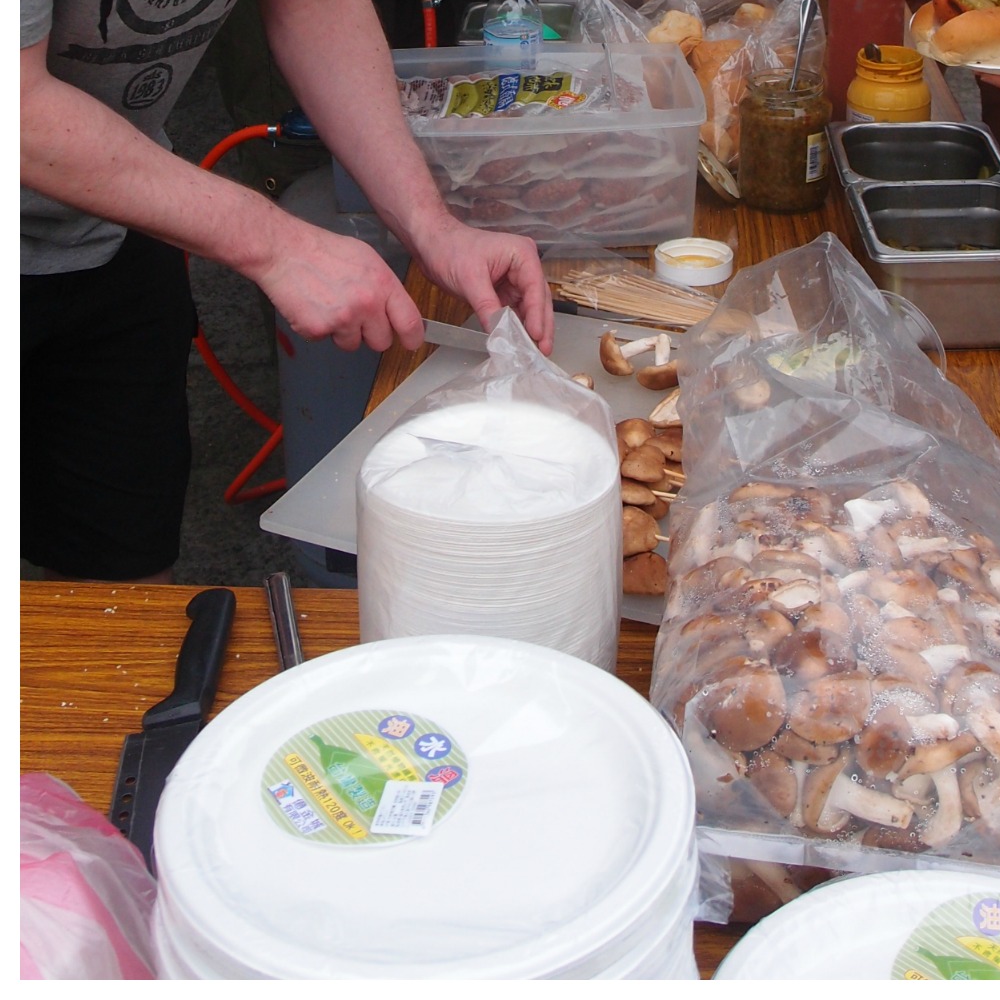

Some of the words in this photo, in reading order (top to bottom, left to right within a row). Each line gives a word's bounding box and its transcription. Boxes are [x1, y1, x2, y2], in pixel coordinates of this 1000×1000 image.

[129, 78, 166, 101] 1983
[380, 716, 411, 738] 油
[418, 735, 448, 758] 水
